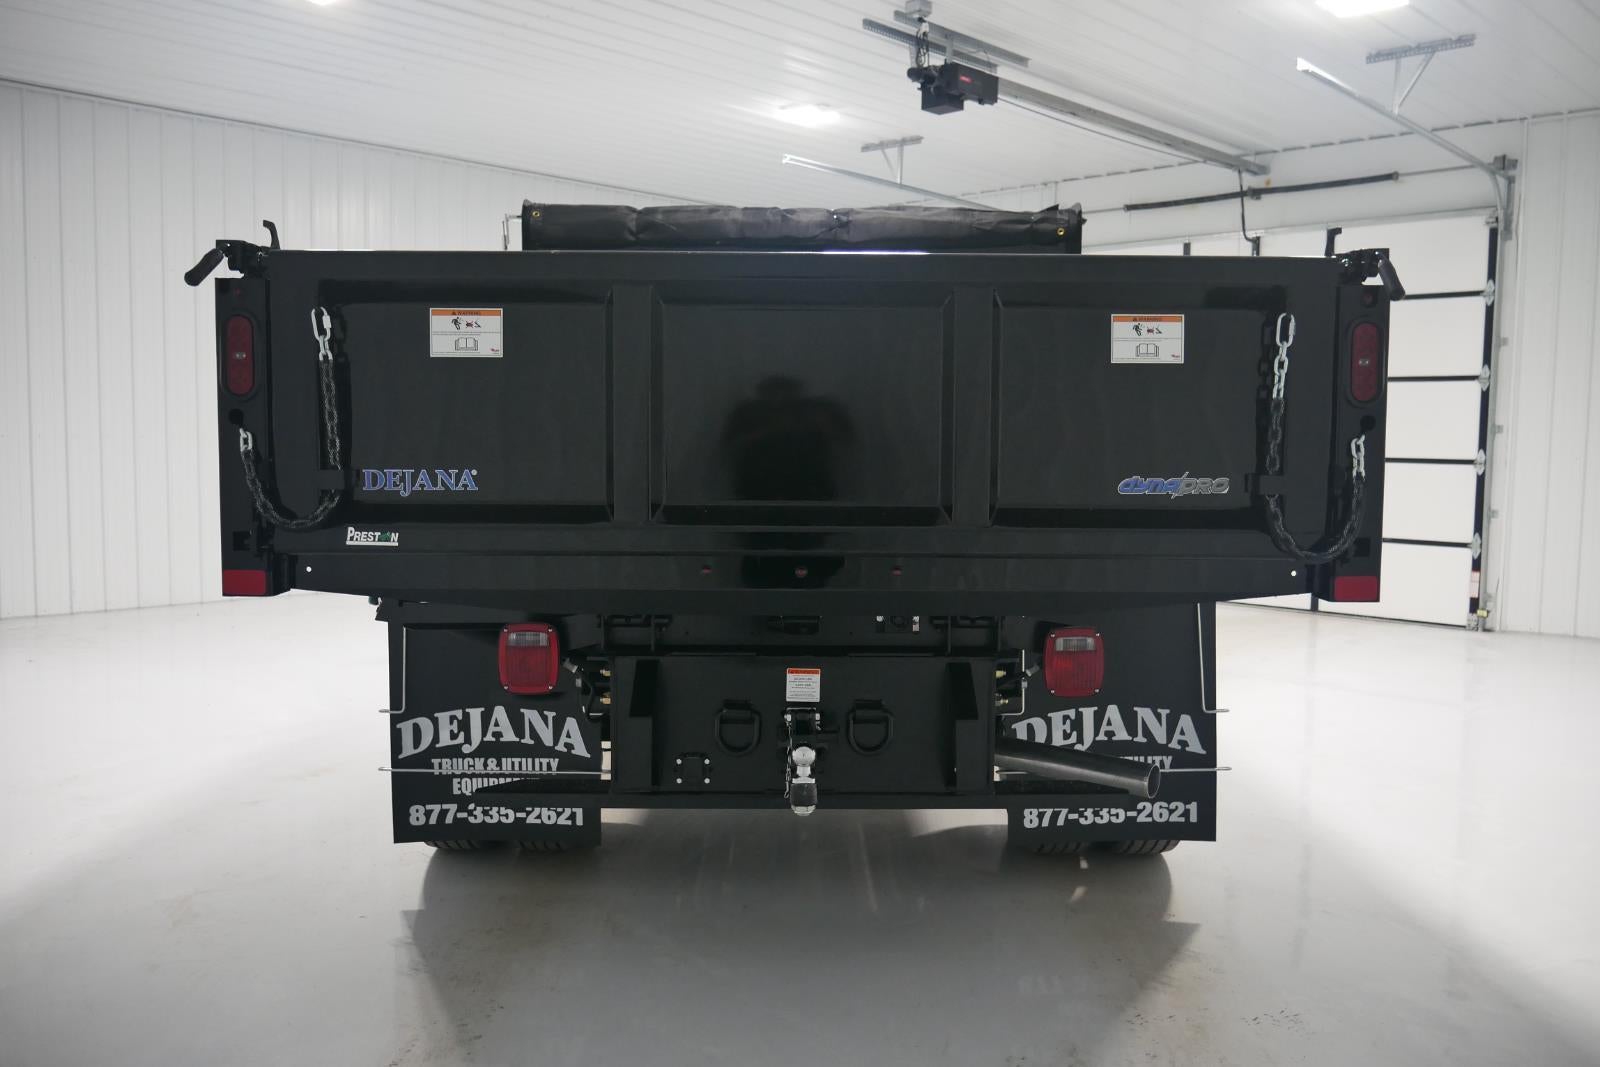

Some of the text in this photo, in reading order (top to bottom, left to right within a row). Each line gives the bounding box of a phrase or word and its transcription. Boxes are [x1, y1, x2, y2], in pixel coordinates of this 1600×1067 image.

[396, 705, 591, 759] DEJANA
[1011, 704, 1207, 755] DEJANA
[409, 803, 584, 827] 877-335-2621
[1023, 801, 1198, 829] 877-335-2621
